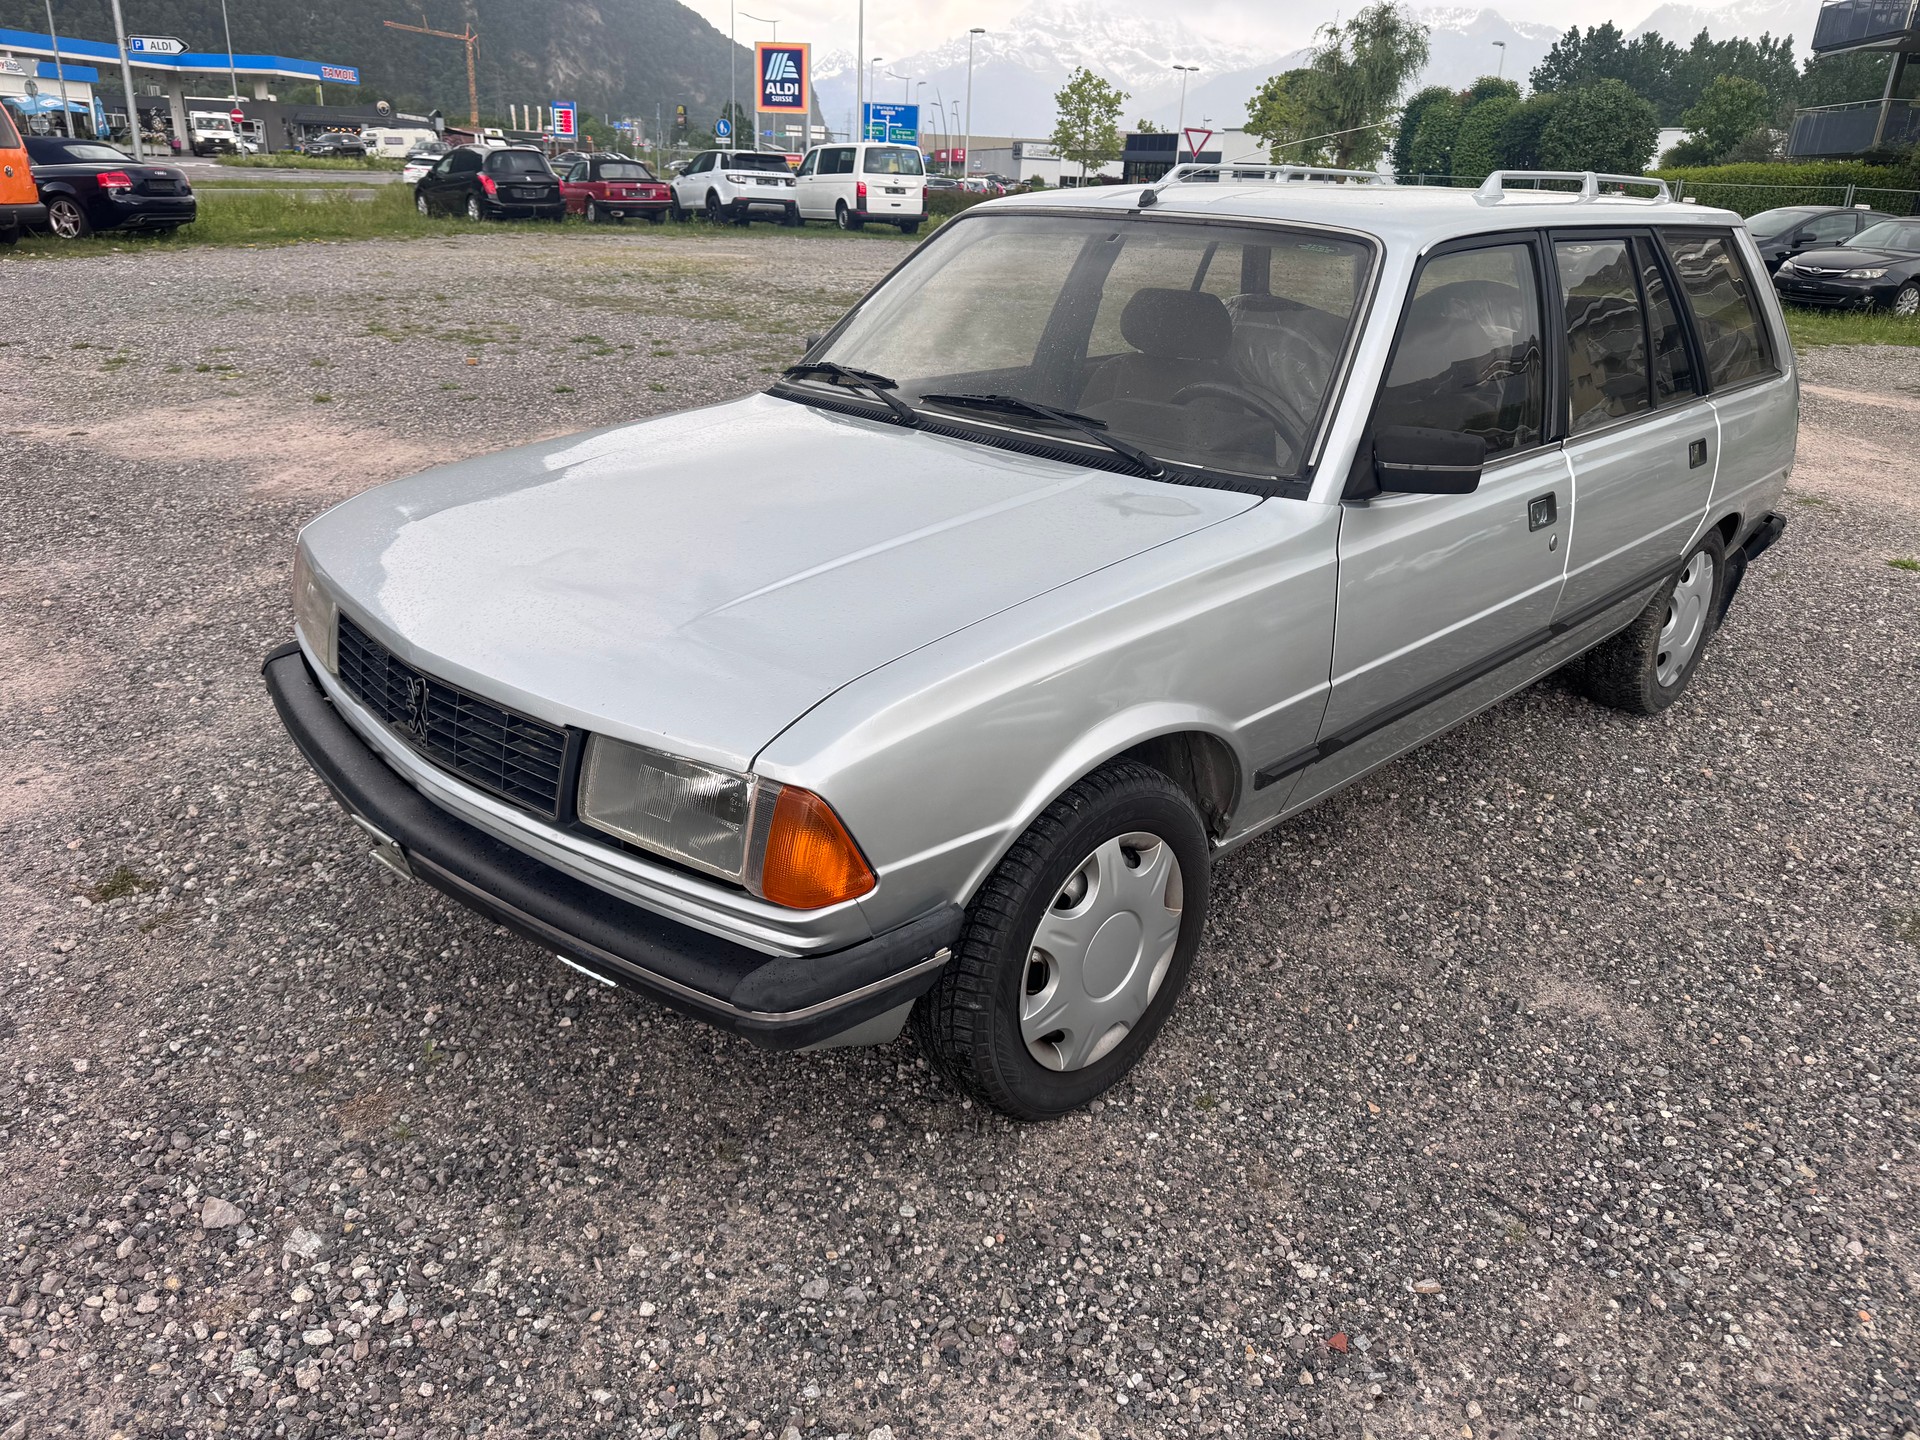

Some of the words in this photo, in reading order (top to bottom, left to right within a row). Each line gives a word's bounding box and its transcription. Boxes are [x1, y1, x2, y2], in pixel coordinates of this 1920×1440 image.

[150, 41, 172, 51] ALDI
[321, 66, 357, 82] TAMOIL
[765, 82, 799, 95] ALDI
[771, 95, 793, 103] SUISSE
